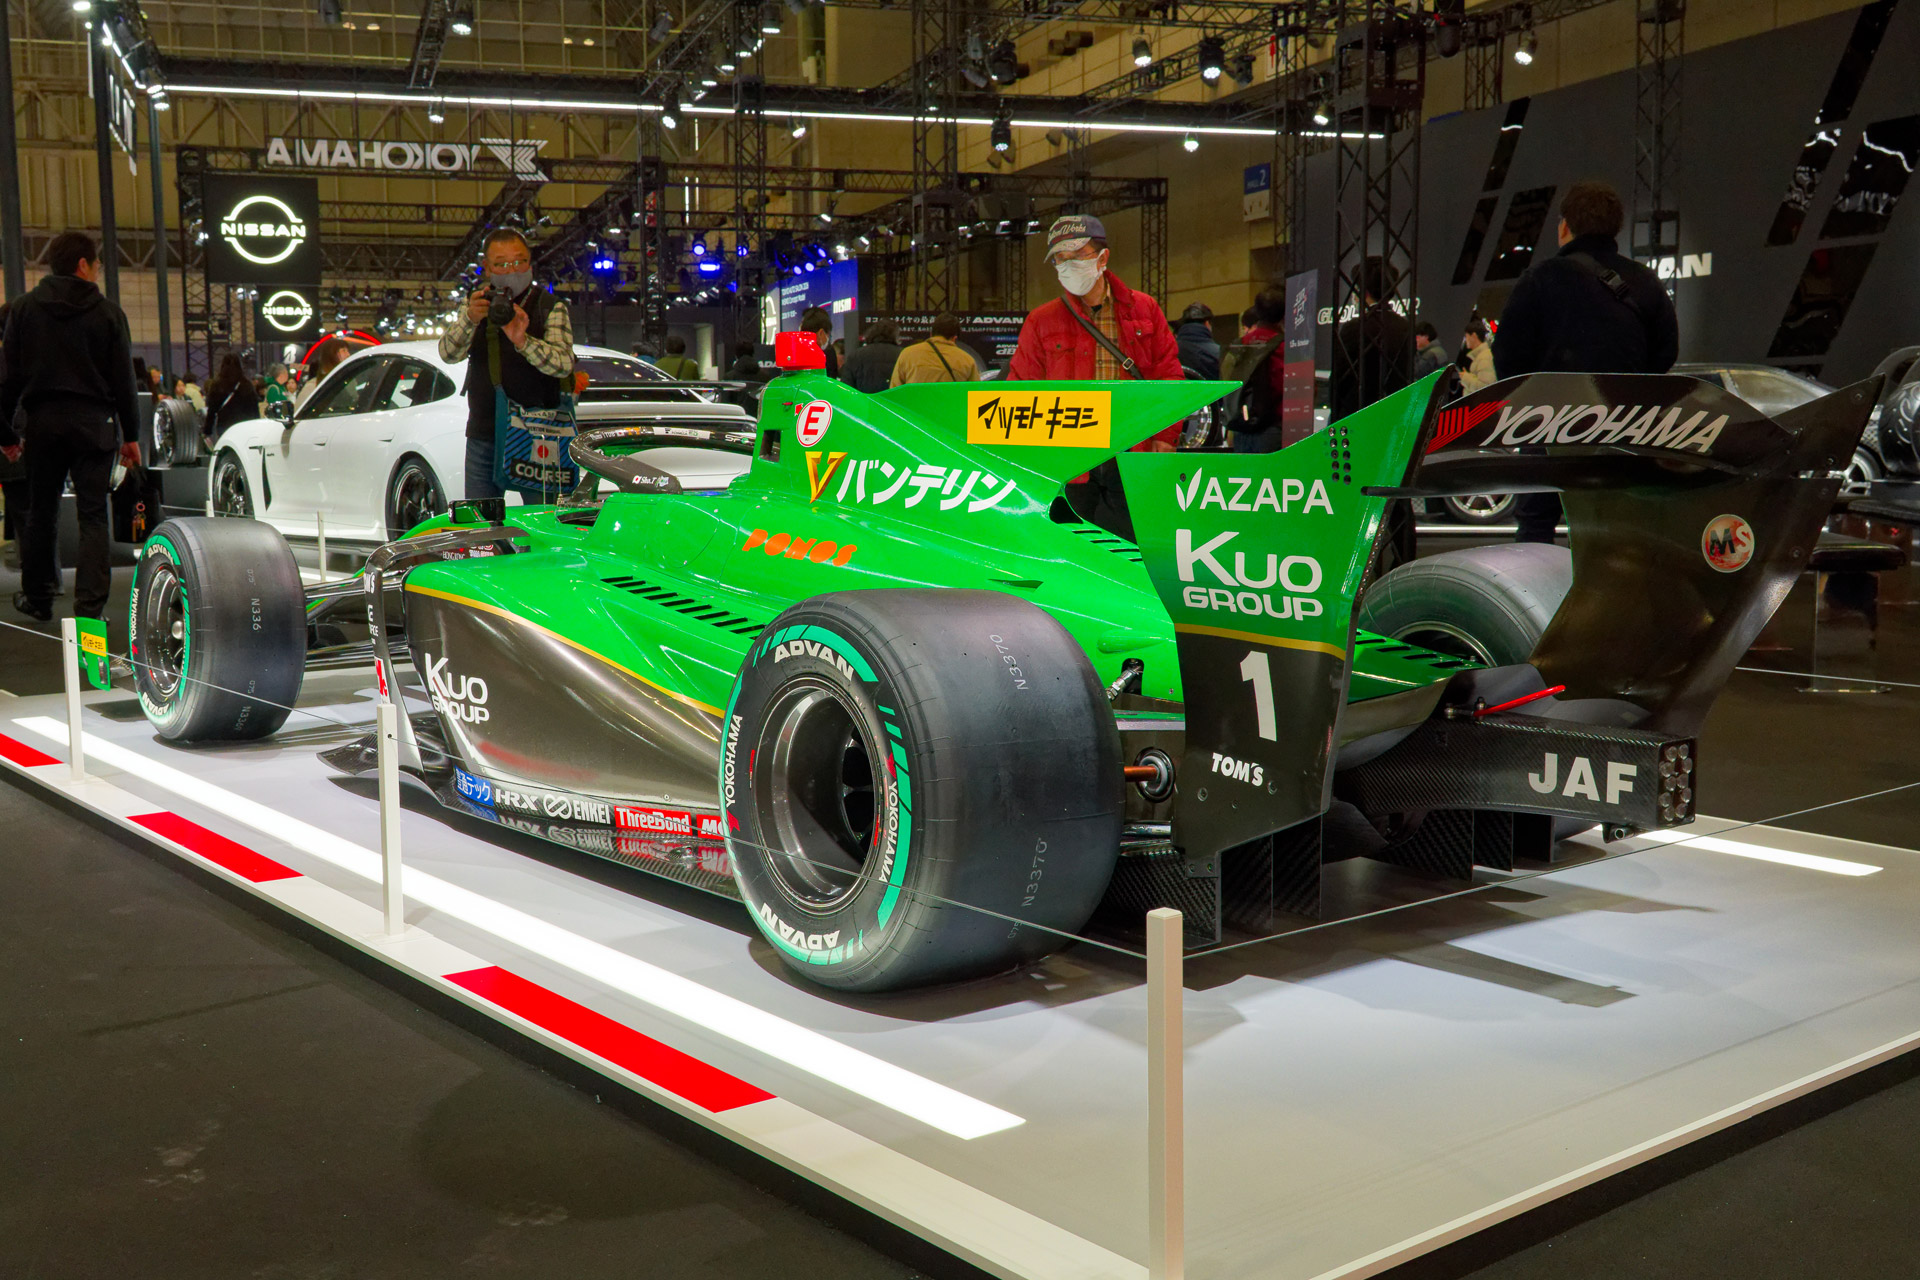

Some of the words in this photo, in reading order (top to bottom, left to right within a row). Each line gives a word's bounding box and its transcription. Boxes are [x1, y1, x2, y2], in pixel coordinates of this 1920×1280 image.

[1259, 169, 1266, 187] 2
[221, 222, 306, 238] NISSAN
[262, 305, 312, 316] NISSAN
[803, 406, 826, 435] E
[977, 396, 1099, 439] マツモトキヨシ
[1478, 404, 1729, 453] YOKOHAMA
[515, 463, 572, 484] COURSE
[836, 459, 1016, 513] バンテリン
[1200, 477, 1334, 515] AZAPA
[148, 543, 174, 565] ADVAN
[742, 528, 857, 566] PONOS
[130, 587, 140, 642] YOKOHAMA
[1183, 586, 1323, 621] GROUP
[775, 639, 854, 681] ADVAN
[989, 634, 1029, 690] N3370
[142, 691, 170, 716] ADVAN
[431, 694, 490, 724] GROUP
[1240, 650, 1277, 742] 1
[725, 714, 743, 808] YOKOHAMA
[1211, 752, 1264, 787] TOM'S
[1528, 752, 1637, 805] JAF
[495, 788, 539, 811] HRX
[573, 799, 611, 825] ENKEI
[616, 807, 690, 833] ThreeBond
[878, 781, 899, 883] YOKOHAMA
[760, 902, 840, 950] ADVAN
